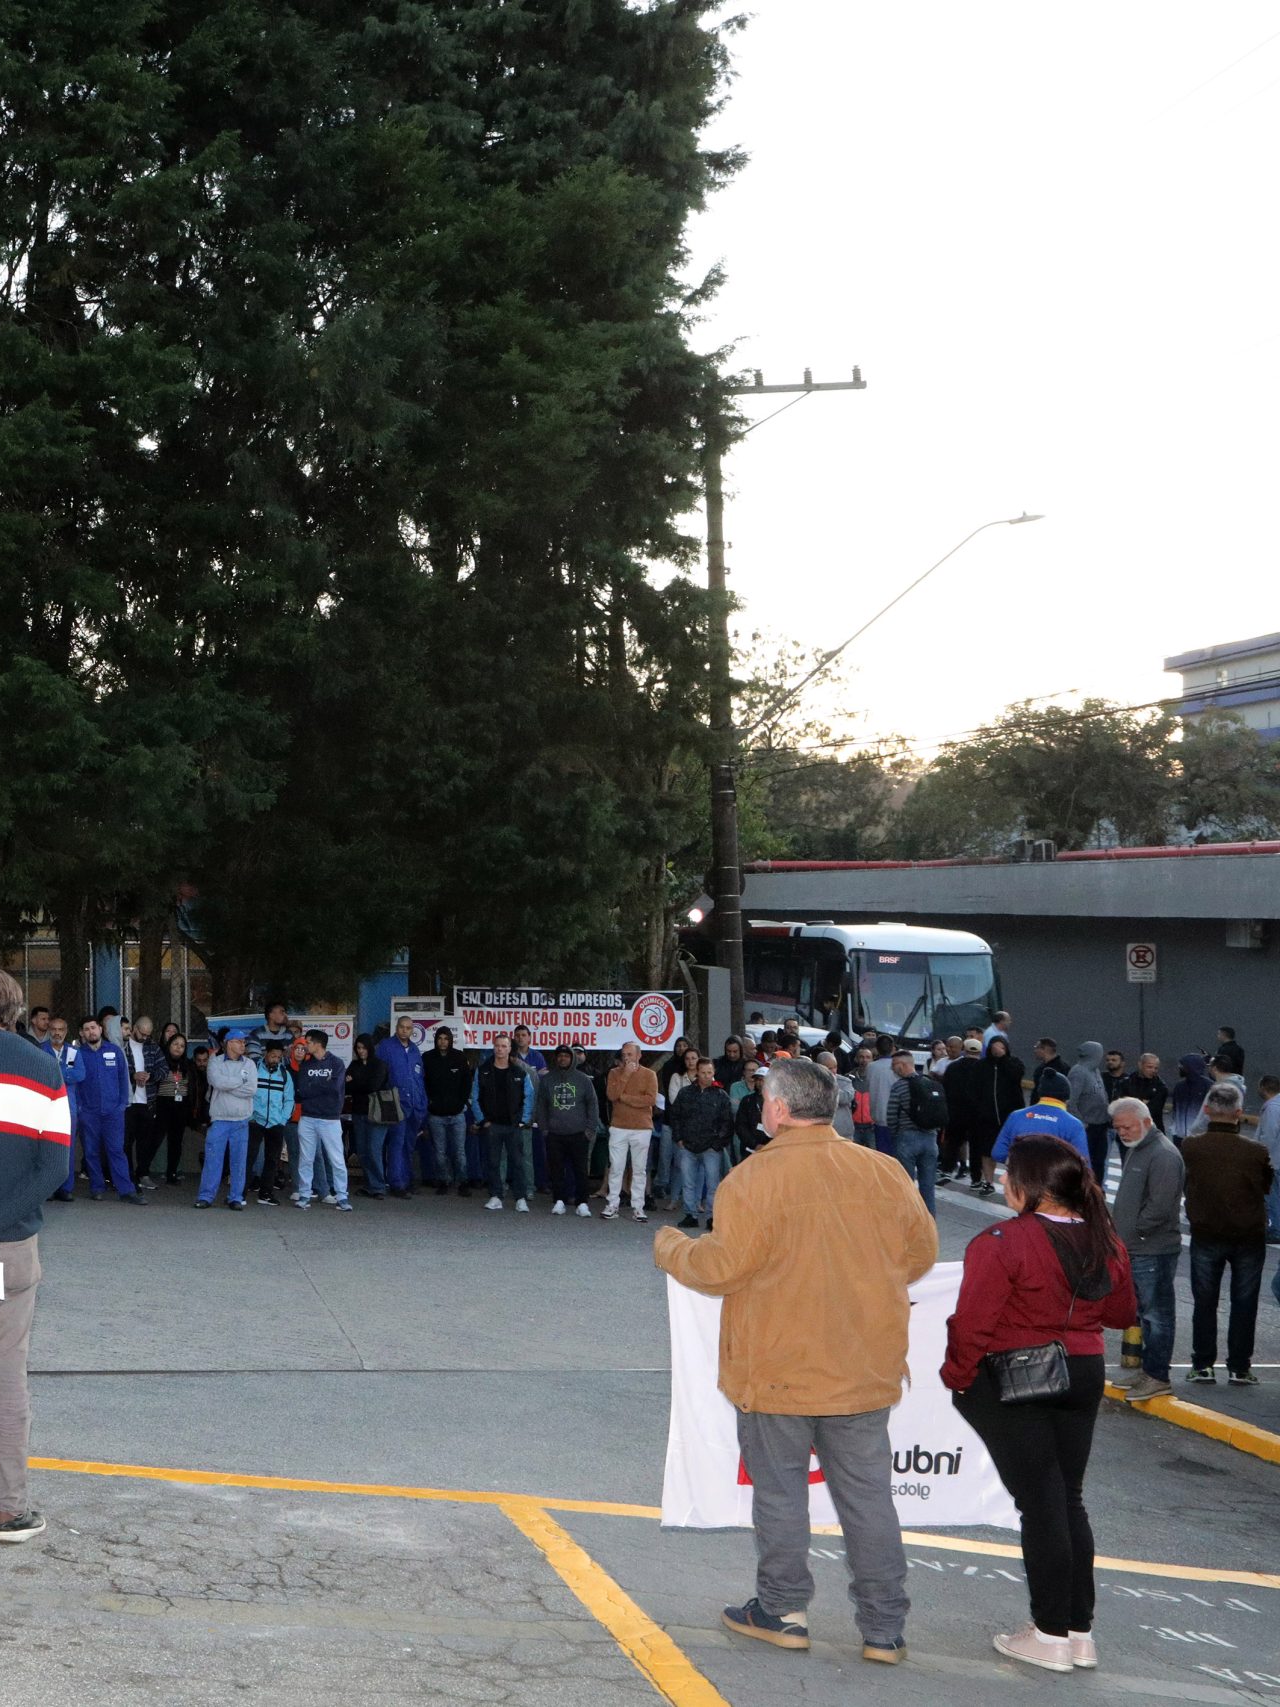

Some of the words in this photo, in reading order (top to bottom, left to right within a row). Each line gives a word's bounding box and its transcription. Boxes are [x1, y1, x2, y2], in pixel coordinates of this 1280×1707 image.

[462, 991, 481, 1004] EM
[485, 991, 528, 1005] DEFESA
[531, 992, 555, 1005] DOS
[559, 993, 626, 1009] EMPREGOS,
[463, 1008, 558, 1029] MANUTENÇÃO
[564, 1012, 590, 1026] DOS
[595, 1012, 627, 1027] 30%
[464, 1030, 478, 1045] DE
